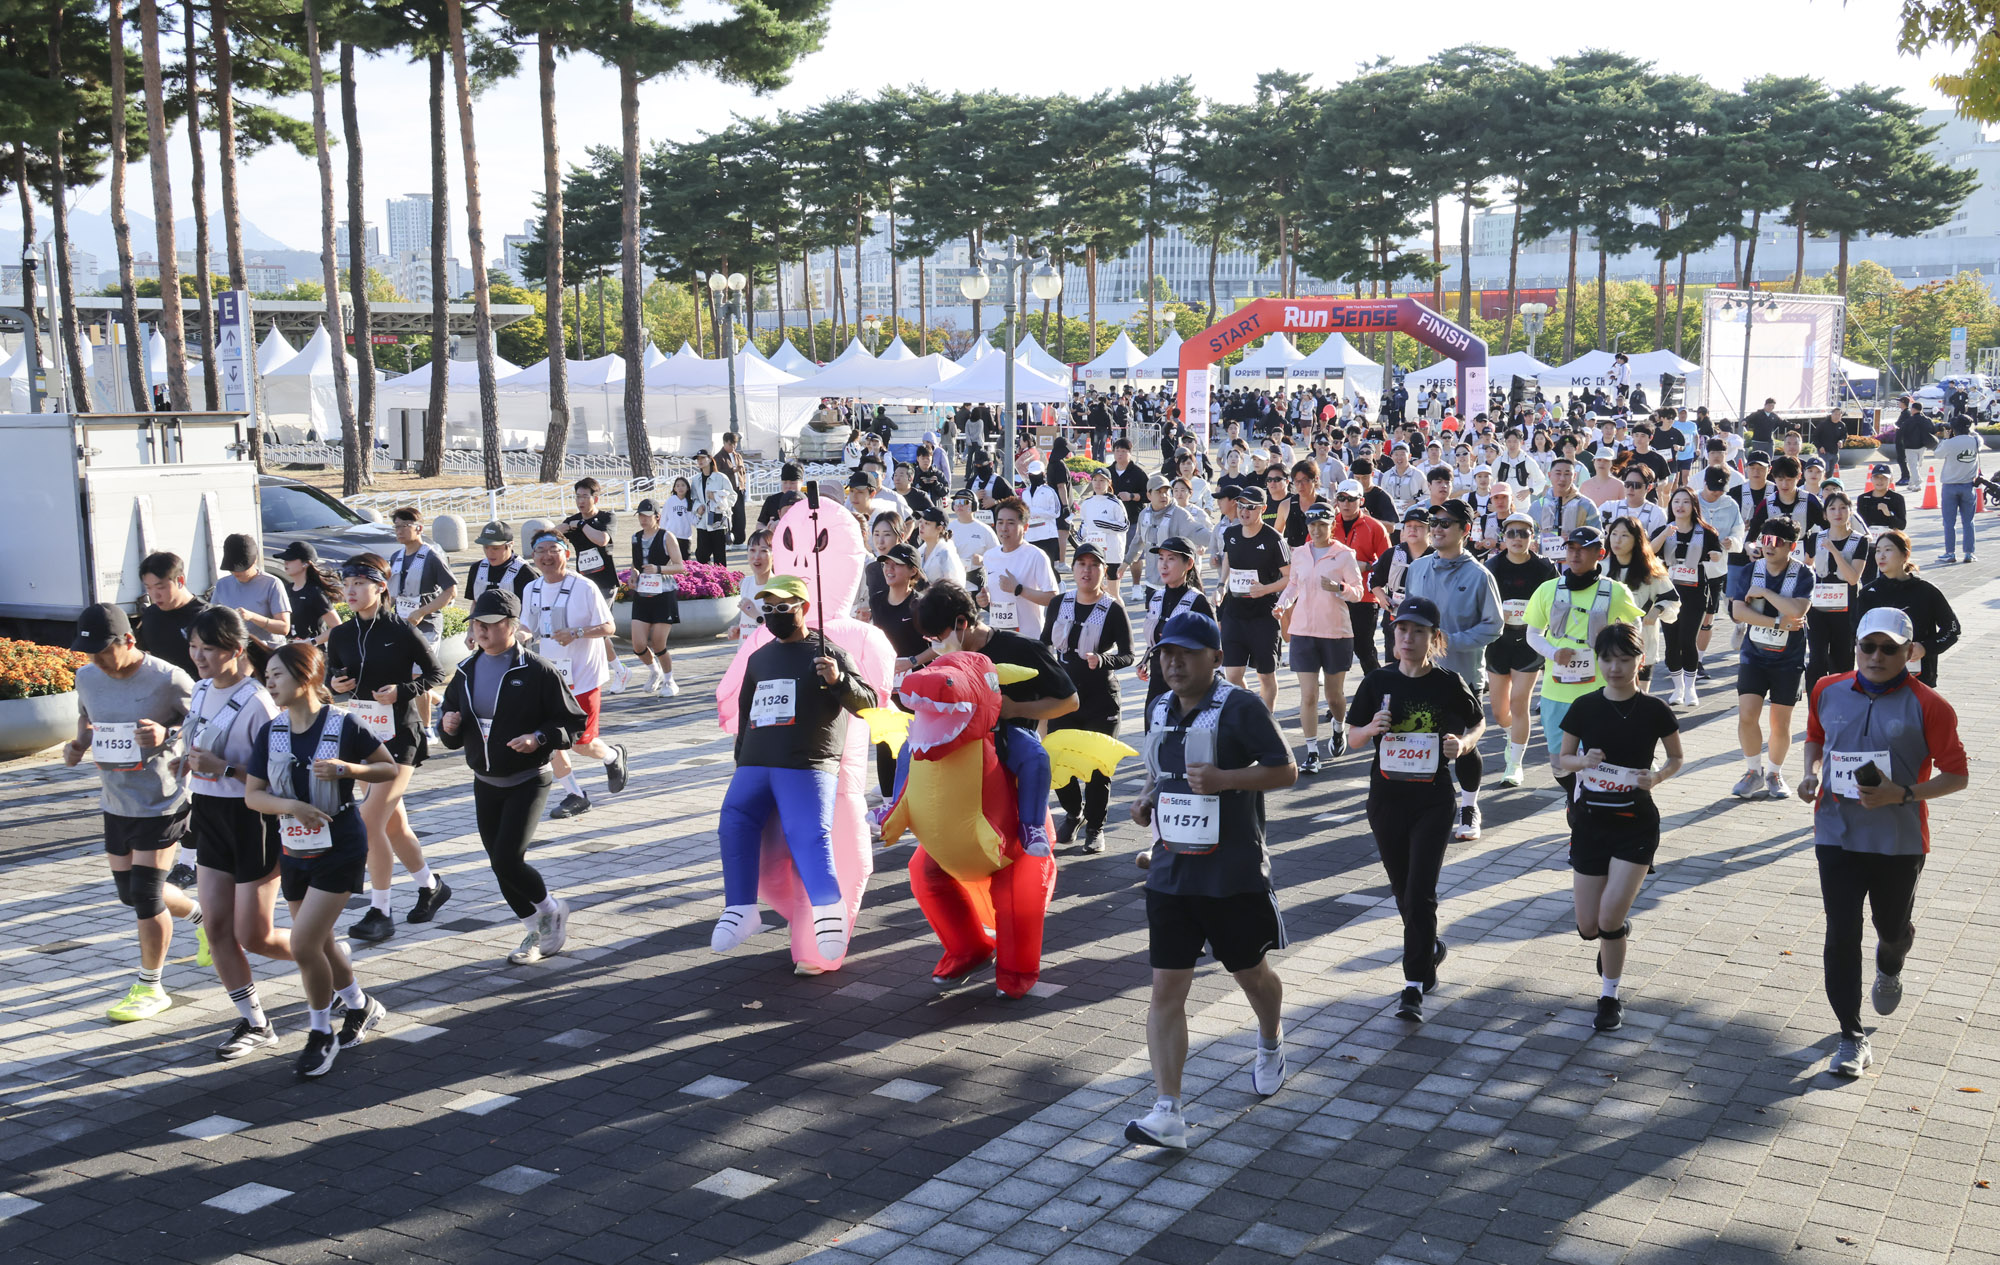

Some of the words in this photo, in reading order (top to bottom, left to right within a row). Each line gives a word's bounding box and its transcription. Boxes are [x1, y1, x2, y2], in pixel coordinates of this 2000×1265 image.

[223, 297, 234, 319] E
[1209, 313, 1262, 353] START
[1416, 311, 1471, 352] FINISH
[1954, 330, 1961, 338] F
[1571, 376, 1591, 386] MC
[583, 555, 599, 565] 1343
[399, 600, 416, 609] 1722
[995, 612, 1013, 620] 1832
[762, 694, 789, 706] 1326
[104, 739, 132, 749] 1533
[1386, 749, 1396, 757] W
[1398, 748, 1431, 759] 2041
[1598, 779, 1633, 792] 2040
[1163, 814, 1170, 823] M
[1173, 814, 1209, 827] 1571
